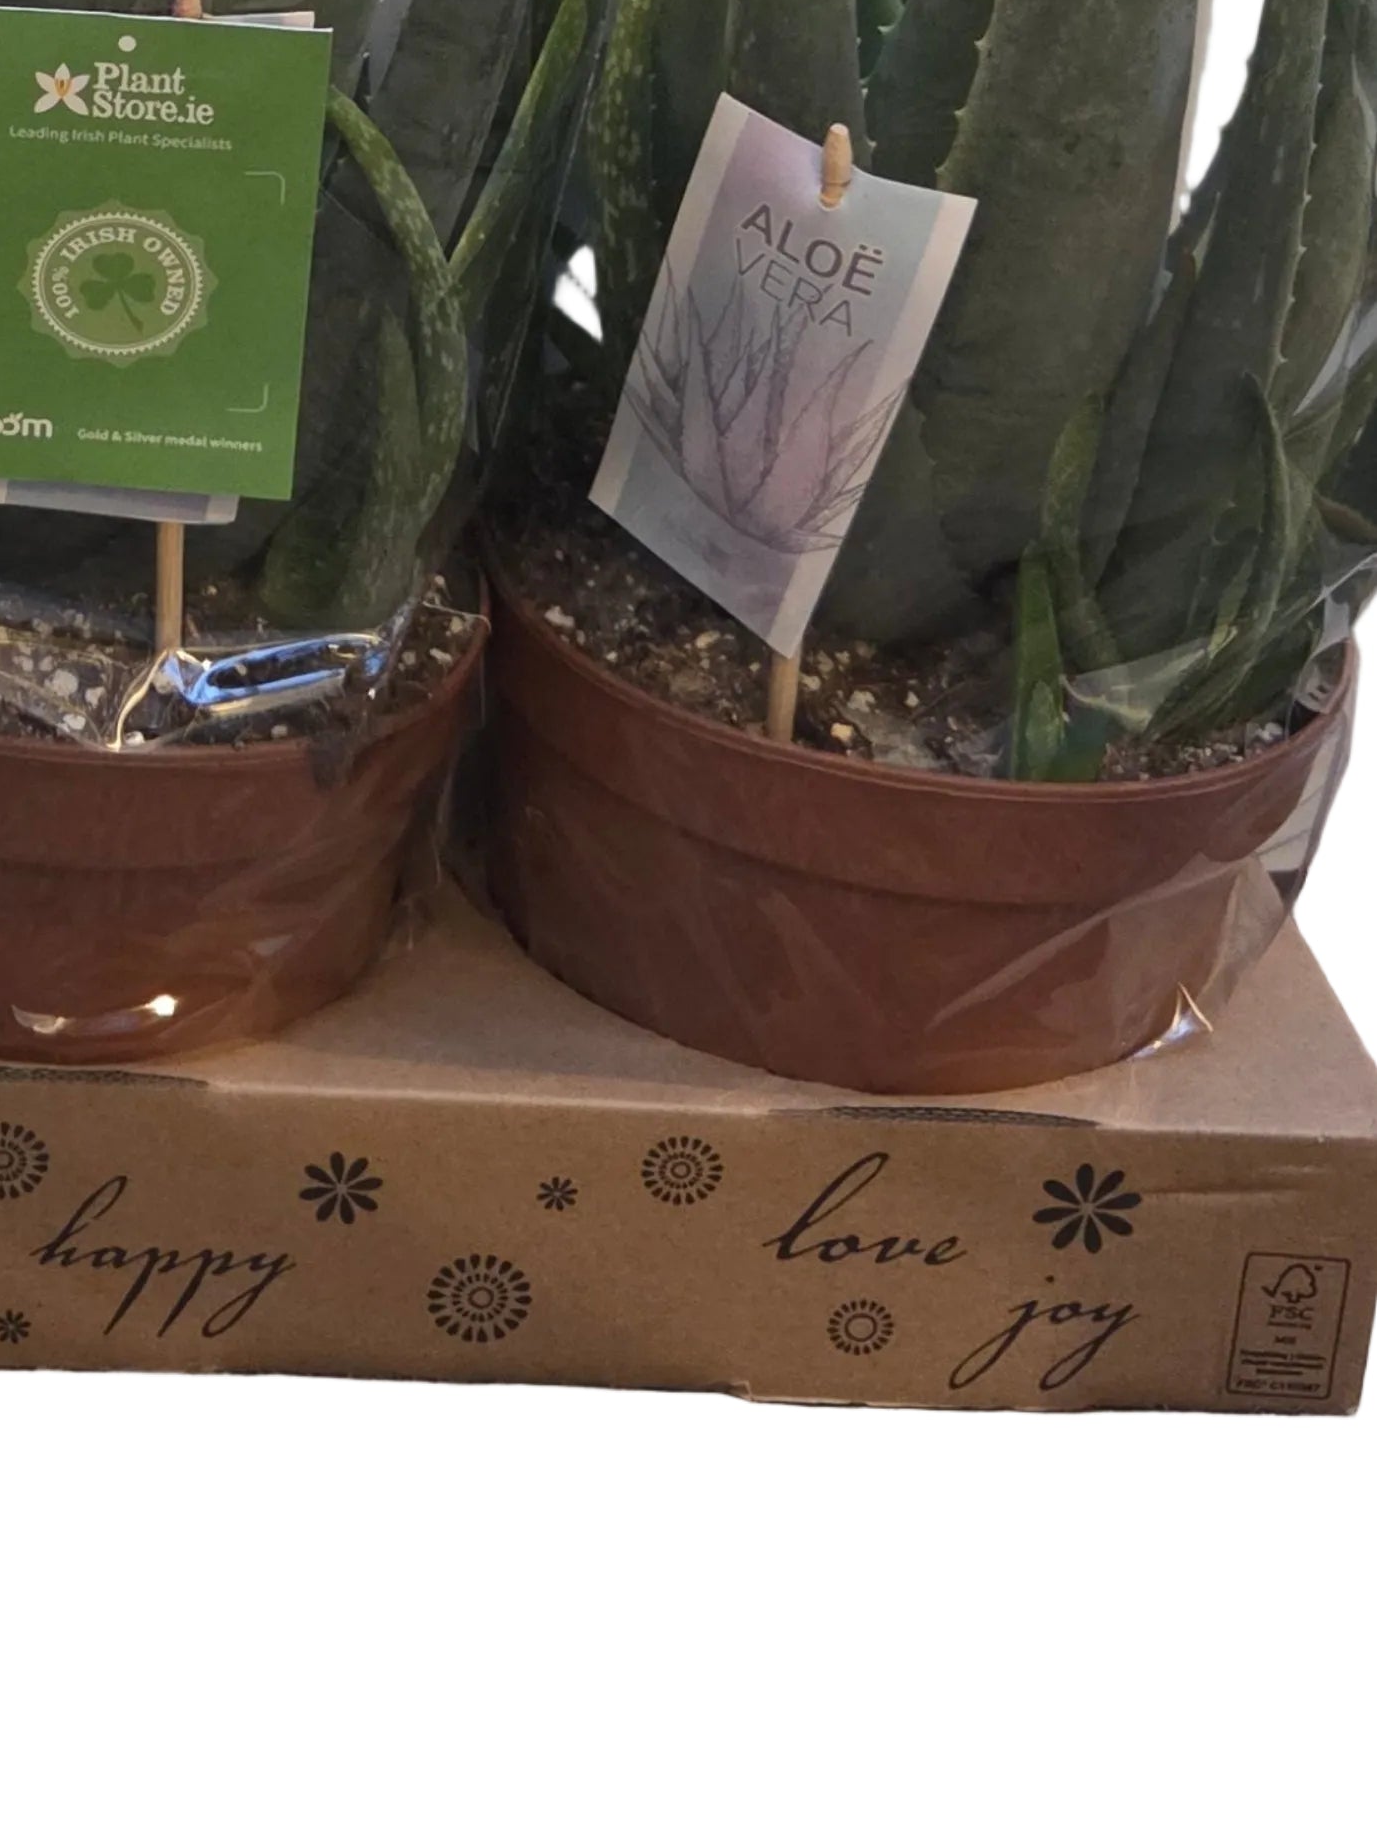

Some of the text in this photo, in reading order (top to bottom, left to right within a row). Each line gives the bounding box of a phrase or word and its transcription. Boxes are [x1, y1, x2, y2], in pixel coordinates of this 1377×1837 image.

[92, 90, 215, 125] Store.ie
[93, 62, 186, 95] Plant
[9, 125, 233, 151] Leading Irish Plant Specialists
[51, 226, 186, 319] 100% IRISH OWNED
[736, 237, 852, 337] VERA
[740, 203, 884, 296] ALOË
[77, 428, 263, 453] Gold & Silver medal winners
[763, 1152, 967, 1265] love
[29, 1174, 297, 1338] happy
[949, 1275, 1141, 1391] joy
[1269, 1304, 1316, 1322] FSC
